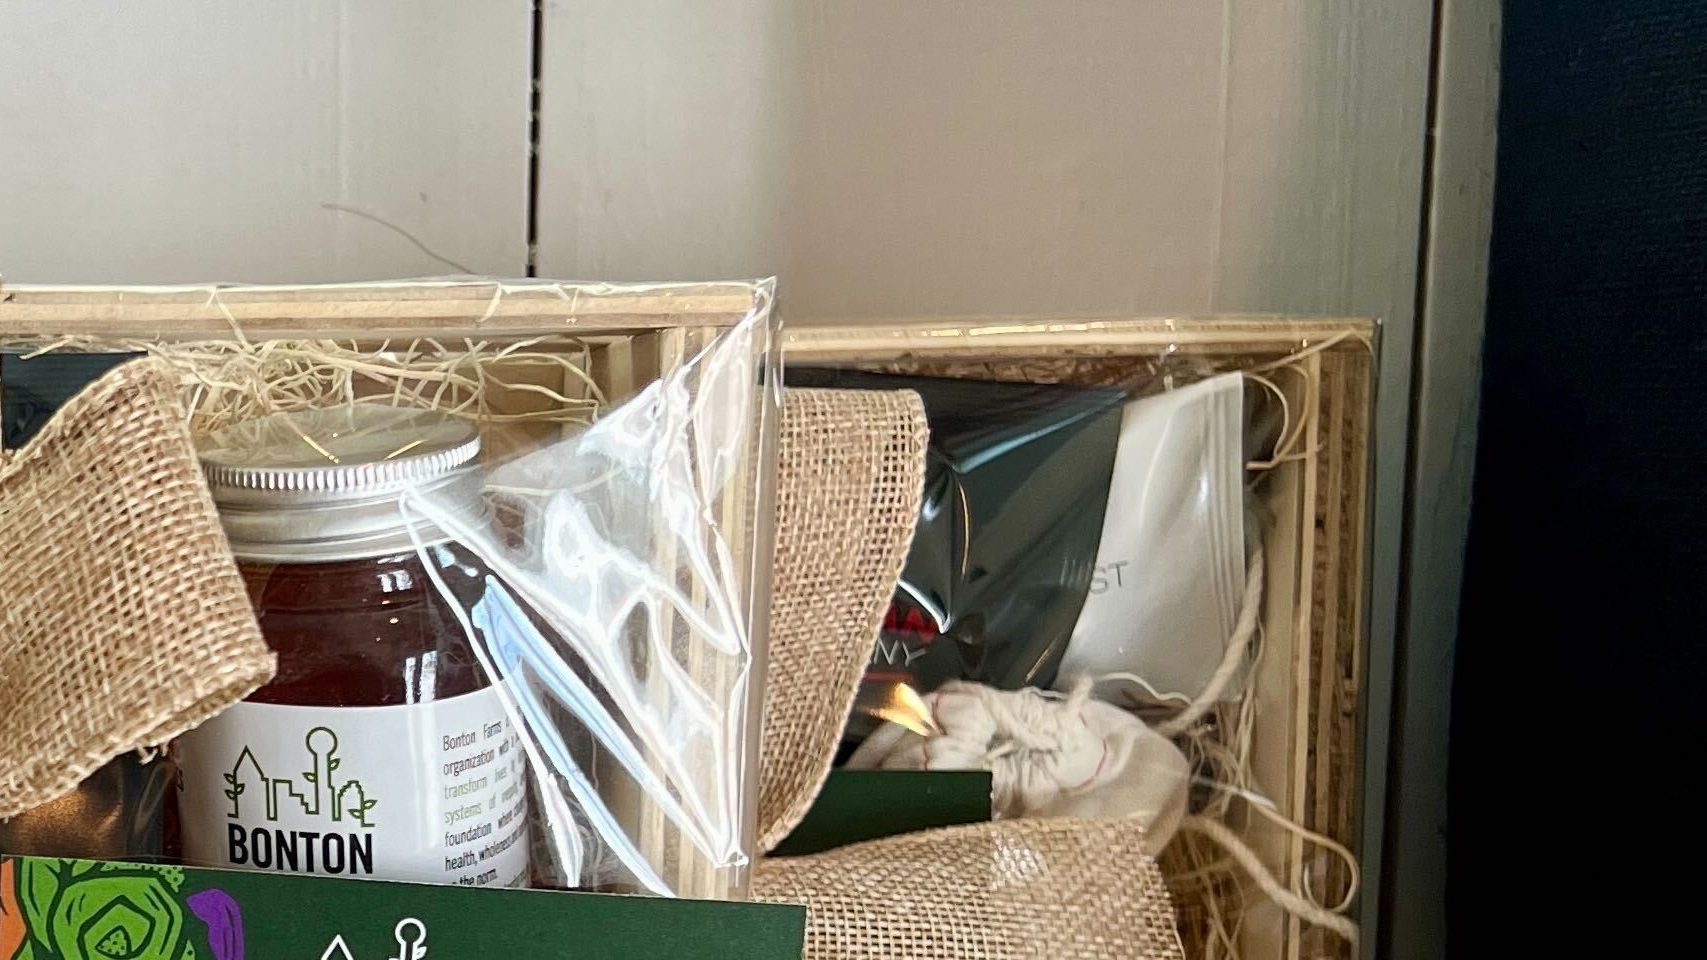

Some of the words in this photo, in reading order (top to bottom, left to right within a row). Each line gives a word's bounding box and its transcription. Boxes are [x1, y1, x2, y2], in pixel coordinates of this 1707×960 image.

[443, 731, 476, 752] Bonton
[483, 720, 502, 741] Farms
[443, 748, 495, 777] organization
[444, 776, 487, 800] transform
[445, 802, 483, 826] systems
[445, 822, 492, 847] foundation
[227, 823, 373, 875] BONTON
[444, 850, 478, 872] health,
